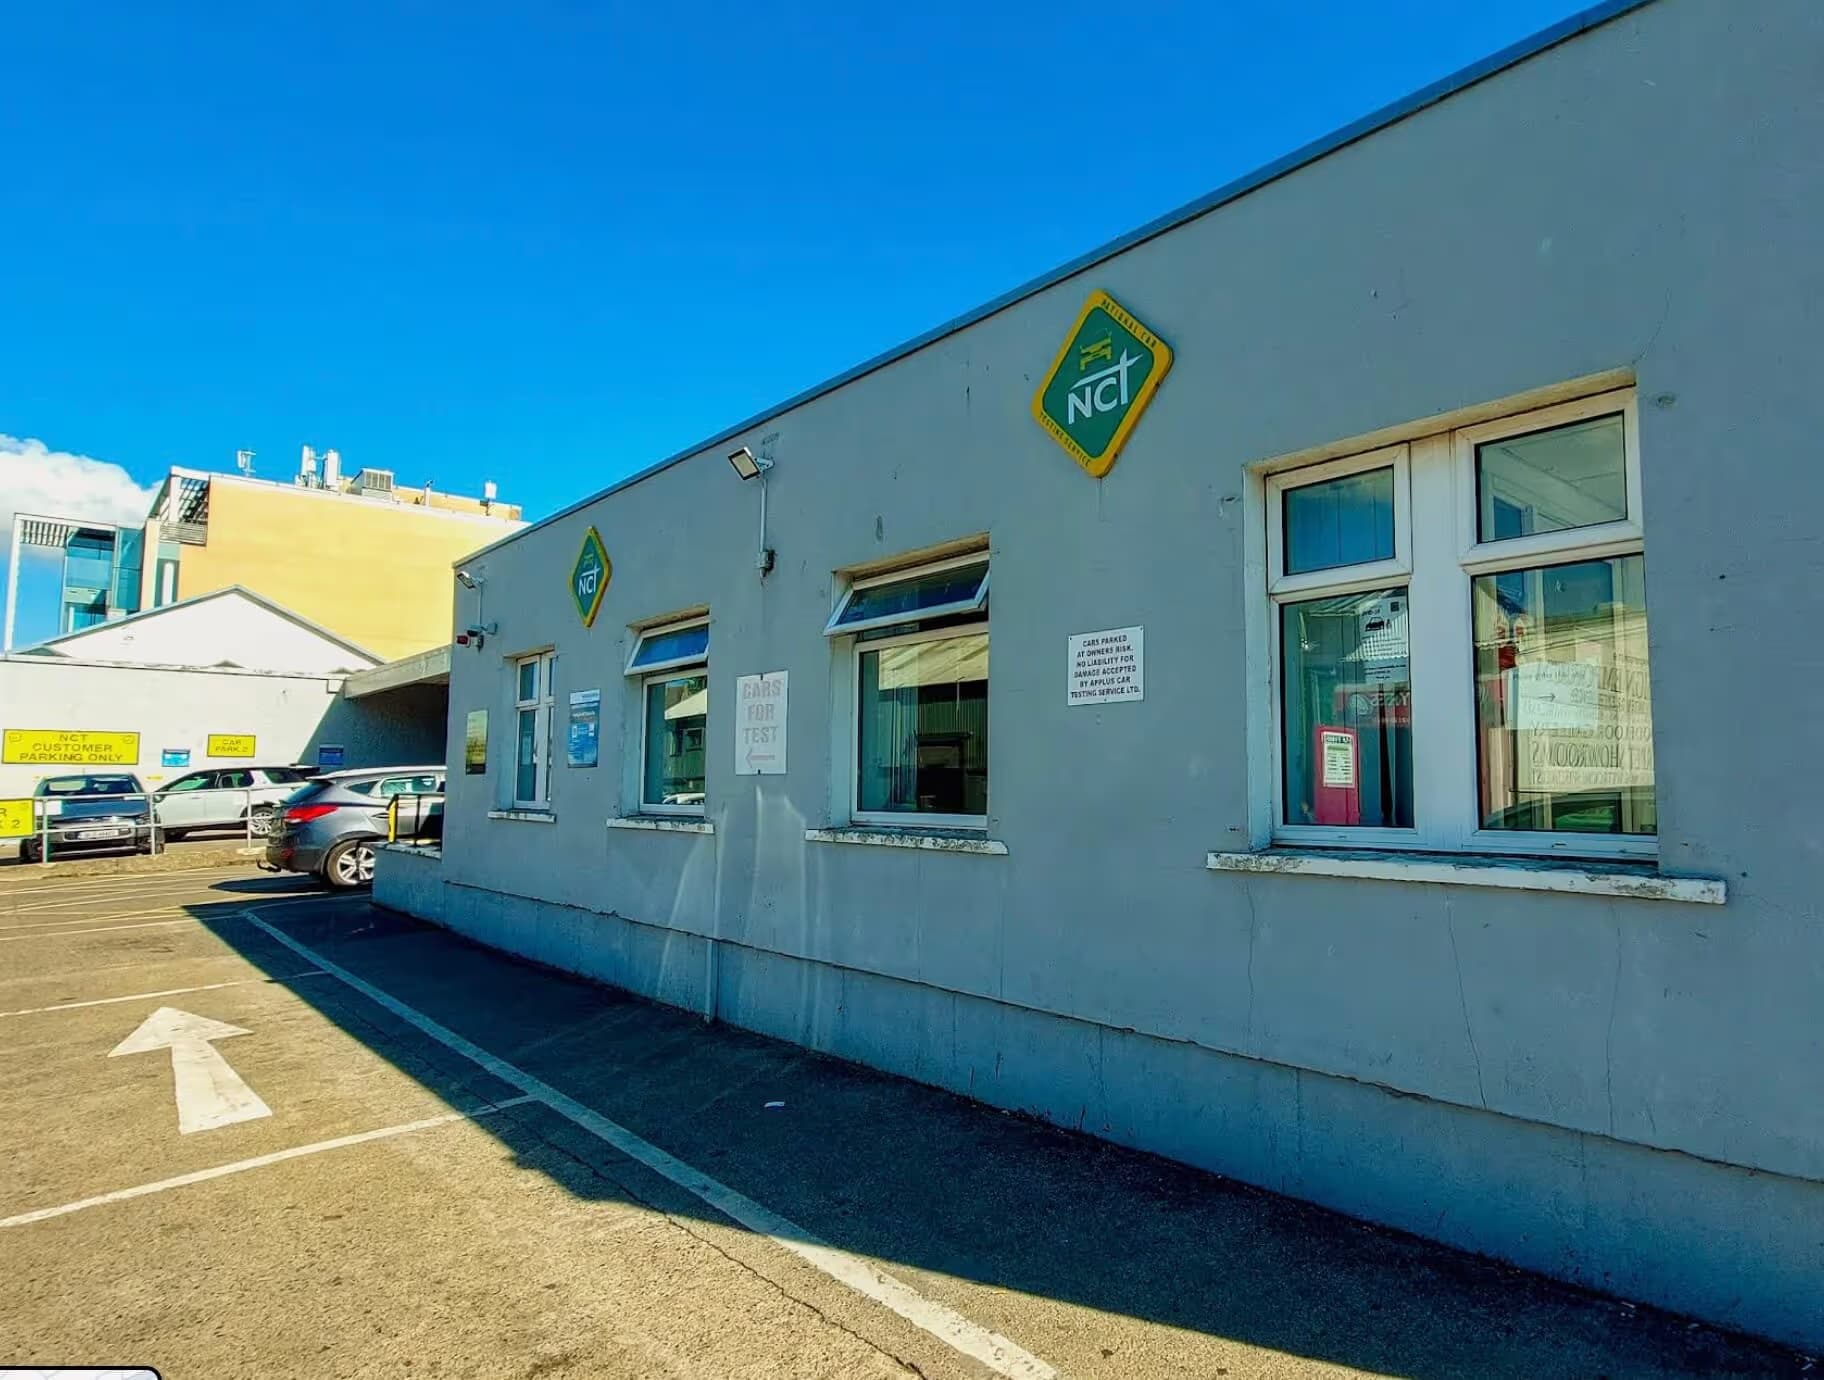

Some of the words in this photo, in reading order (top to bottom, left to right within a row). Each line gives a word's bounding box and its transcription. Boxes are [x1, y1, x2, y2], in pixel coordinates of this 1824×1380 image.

[1067, 347, 1144, 425] NCT
[578, 563, 601, 597] NCT
[1083, 639, 1099, 647] CARS
[1101, 635, 1127, 644] PARKED
[1087, 648, 1113, 657] OWNERS
[1087, 657, 1118, 666] LIABILITY
[1074, 669, 1100, 678] DAMAGE
[1102, 665, 1136, 675] ACCEPTED
[1090, 678, 1115, 686] APPLUS
[1117, 676, 1131, 684] CAR
[743, 679, 782, 700] CARS
[1071, 690, 1096, 698] TESTING
[1098, 688, 1125, 696] SERVICE
[747, 703, 775, 721] FOR
[59, 734, 89, 742] NCT
[743, 726, 779, 745] TEST
[32, 743, 113, 752] CUSTOMER
[20, 753, 82, 761] PARKING
[88, 753, 123, 762] ONLY
